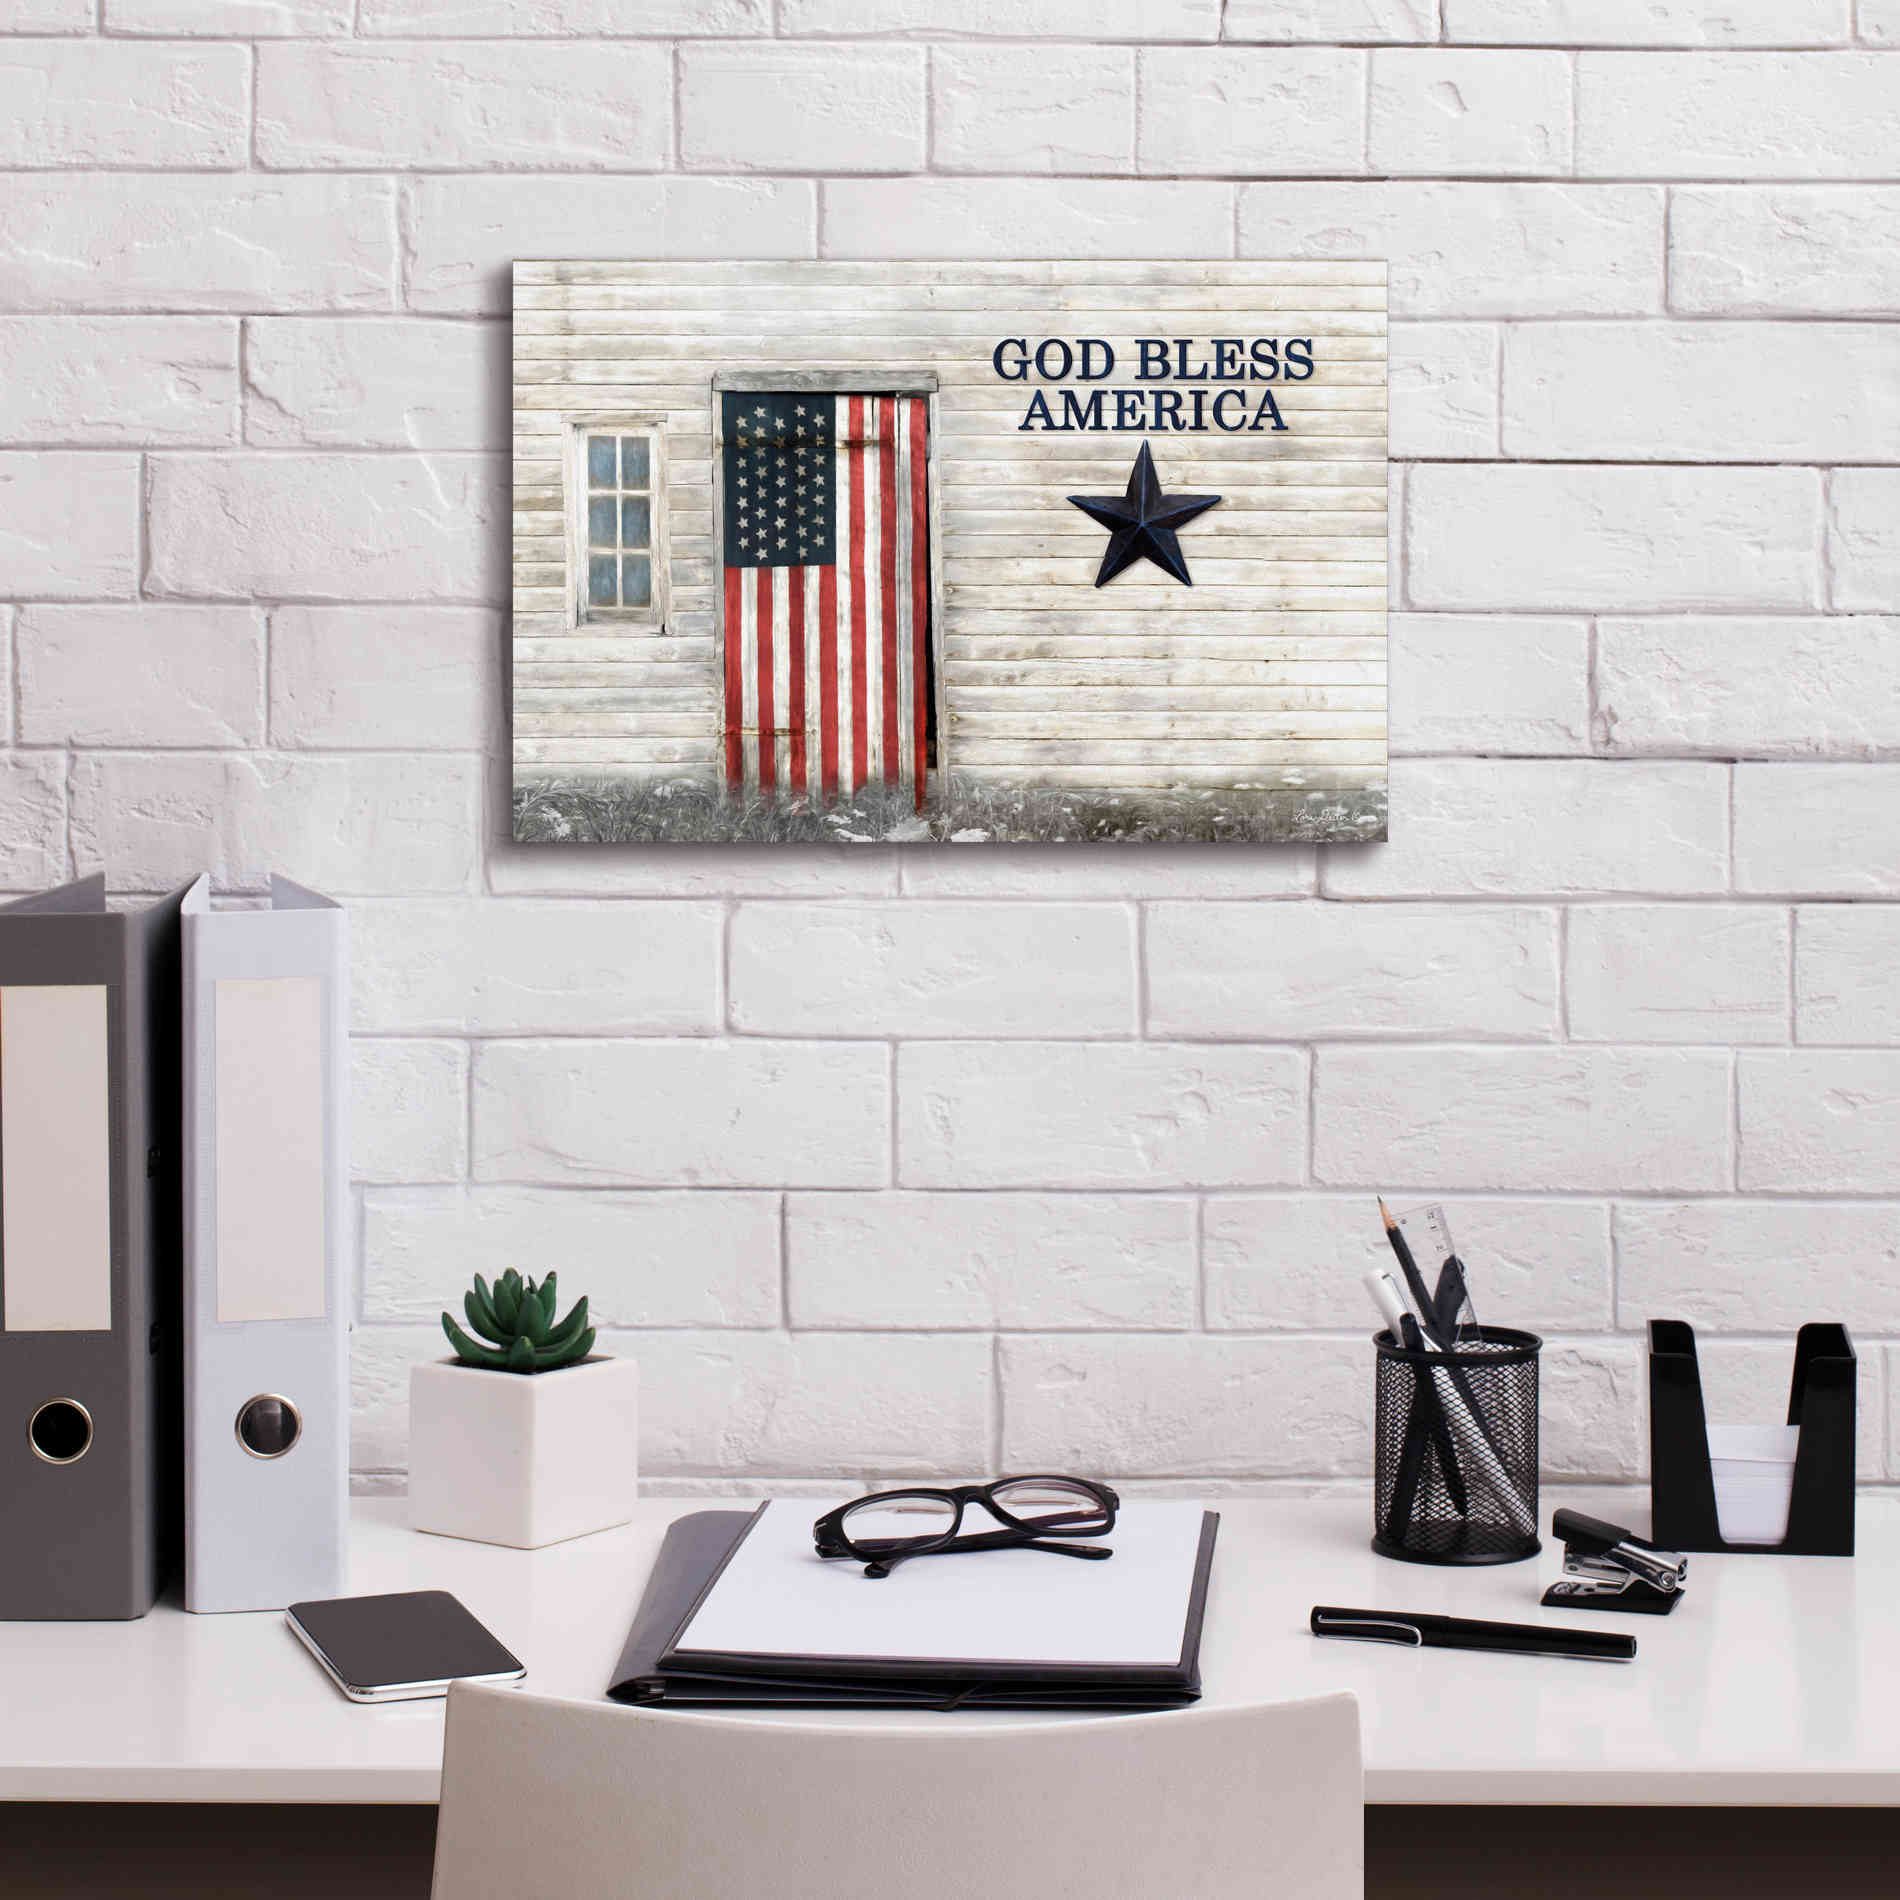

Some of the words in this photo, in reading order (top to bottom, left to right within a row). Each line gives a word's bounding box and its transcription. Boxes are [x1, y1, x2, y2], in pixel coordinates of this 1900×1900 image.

[992, 338, 1115, 381] GOD
[1134, 338, 1314, 381] BLESS
[1018, 389, 1289, 431] AMERICA
